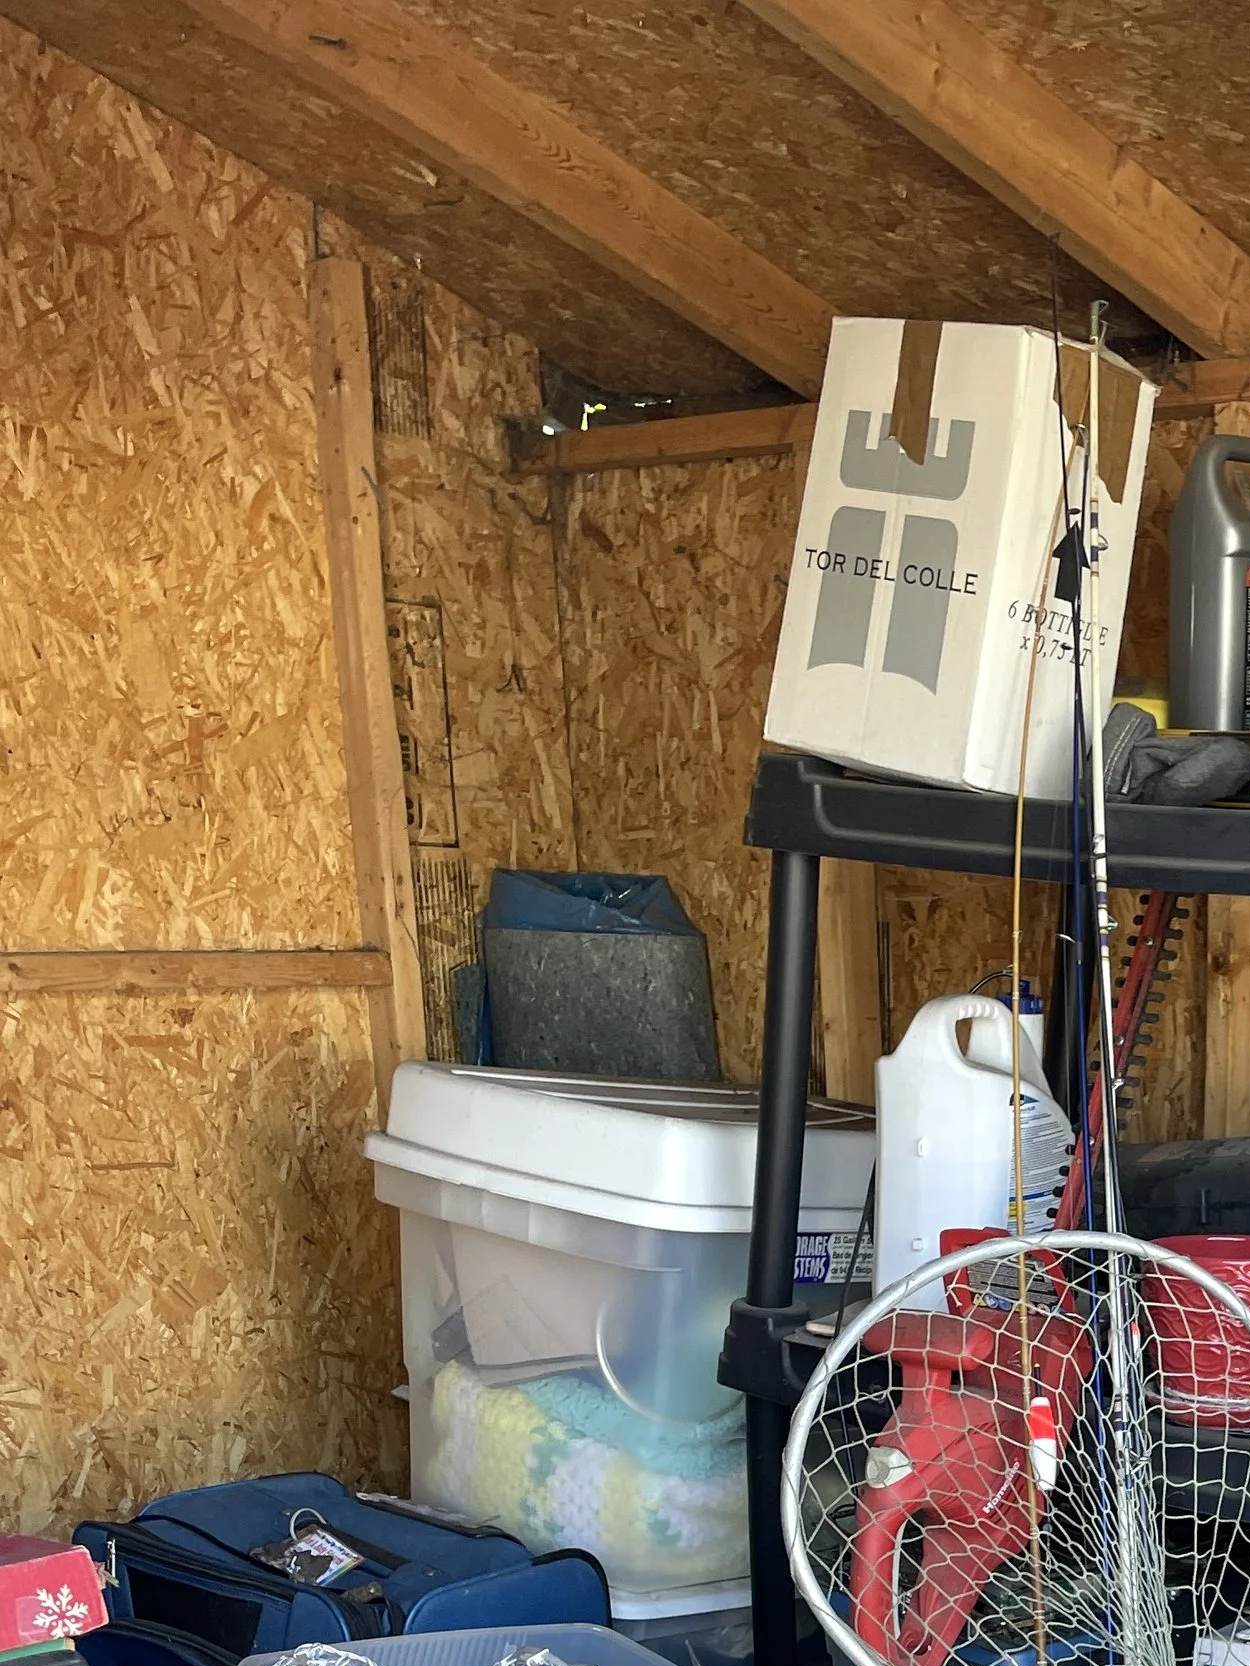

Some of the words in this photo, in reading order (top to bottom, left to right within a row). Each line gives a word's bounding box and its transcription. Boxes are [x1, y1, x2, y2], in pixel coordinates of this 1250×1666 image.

[806, 549, 846, 573] TOR
[854, 557, 895, 581] DEL
[904, 565, 978, 595] COLLE
[1008, 600, 1019, 619] 6
[1021, 604, 1109, 646] BOTTILE
[1020, 636, 1031, 650] x
[796, 1236, 829, 1257] RAGE
[794, 1257, 828, 1280] STEMS
